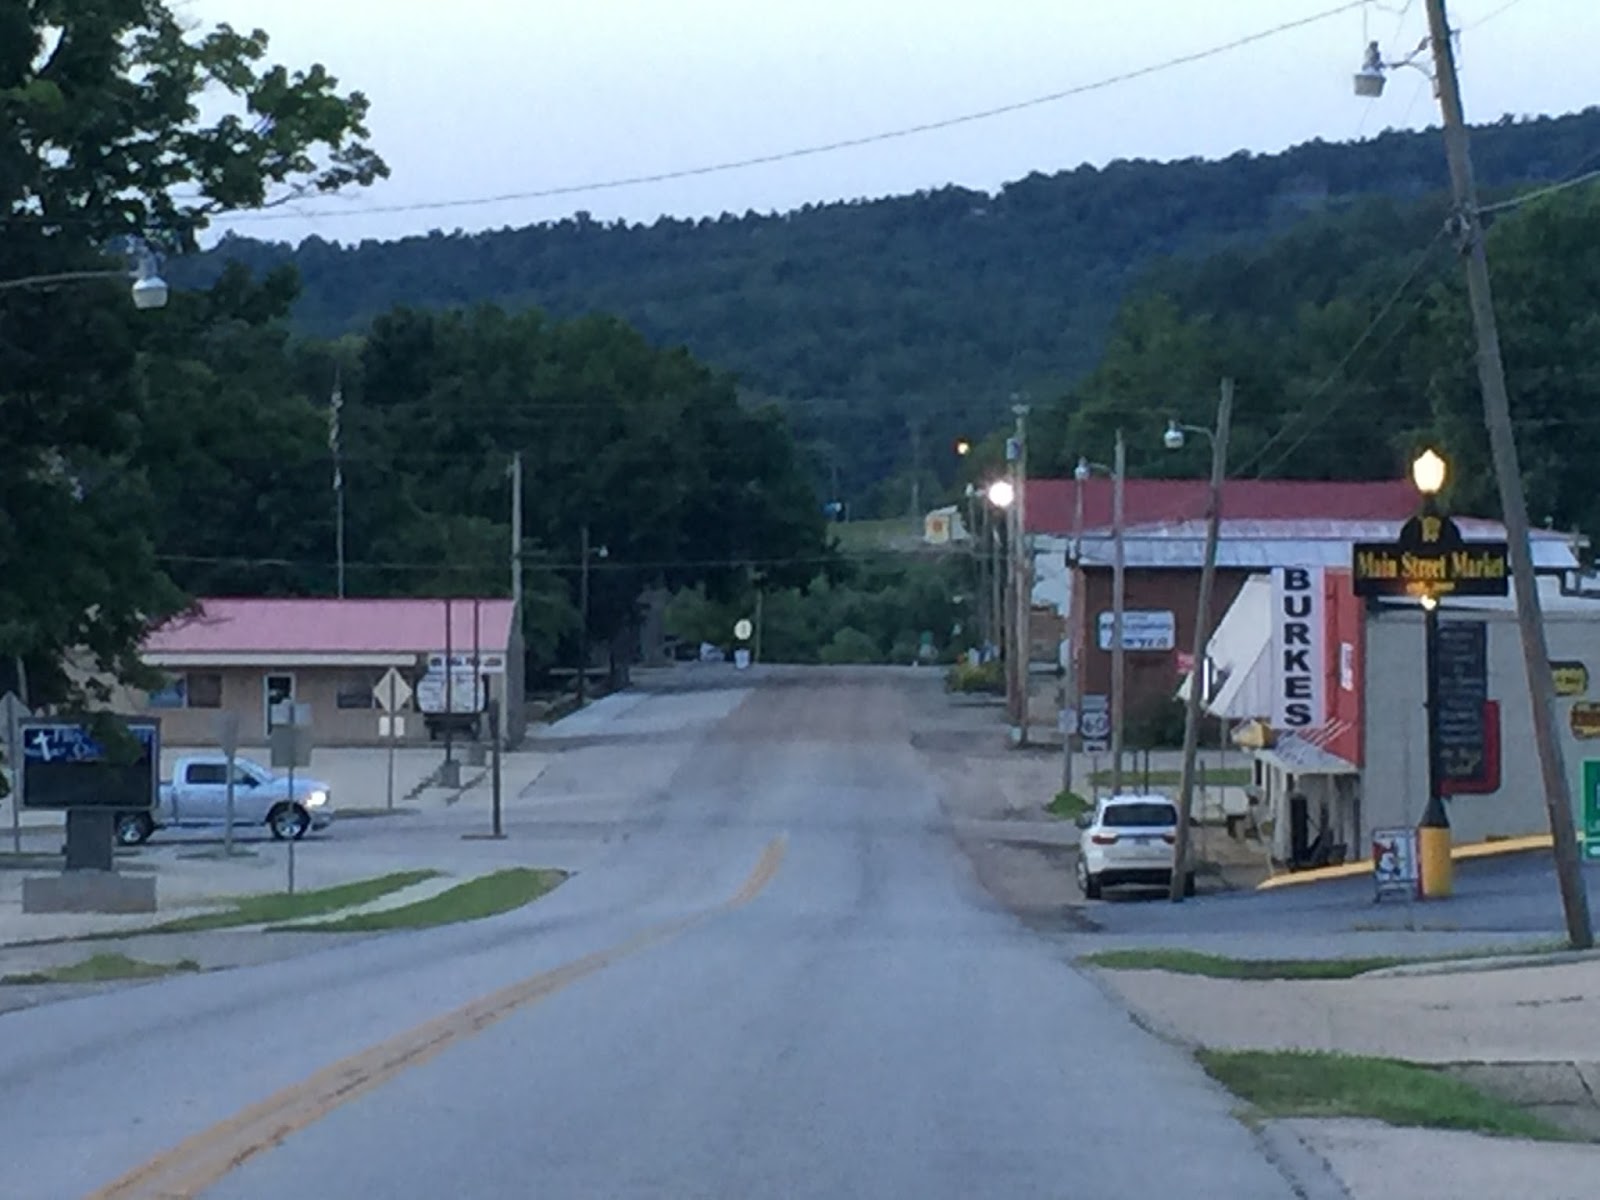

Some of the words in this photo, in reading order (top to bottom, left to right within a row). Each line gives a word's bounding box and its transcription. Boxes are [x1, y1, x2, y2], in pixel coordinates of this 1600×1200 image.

[1358, 552, 1397, 578] Main
[1402, 552, 1446, 578] Street
[1451, 551, 1504, 578] Market
[1284, 569, 1311, 726] BURKES
